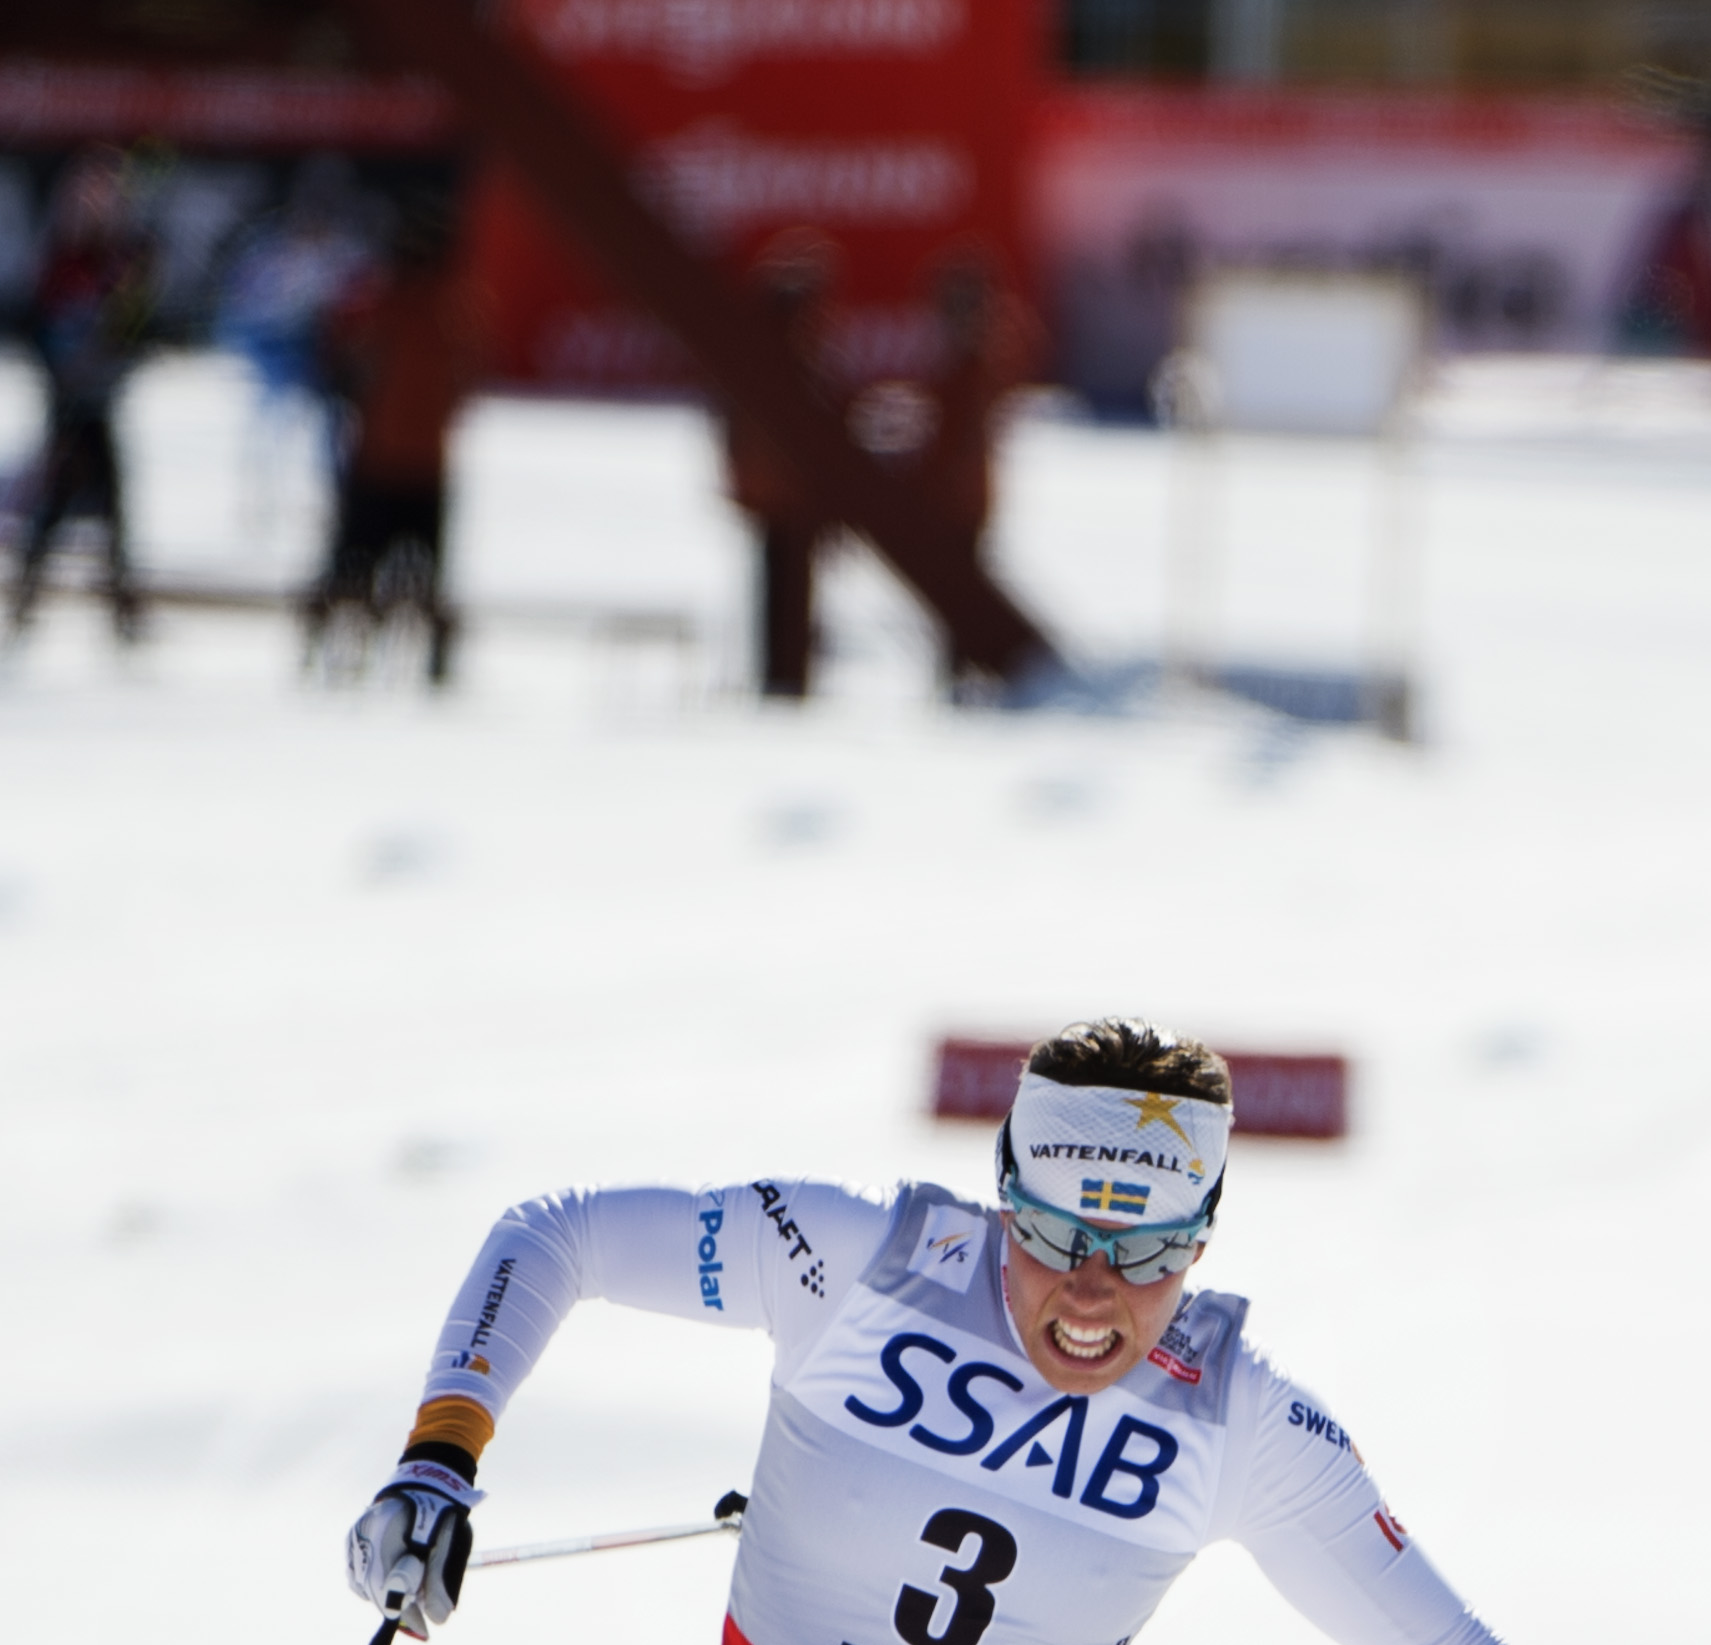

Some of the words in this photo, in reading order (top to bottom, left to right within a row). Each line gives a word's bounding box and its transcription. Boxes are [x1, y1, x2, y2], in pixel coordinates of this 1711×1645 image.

[1029, 1143, 1182, 1174] VATTENFALL
[469, 1258, 517, 1348] VATTENFALL
[698, 1209, 724, 1311] Polar
[843, 1332, 1180, 1520] SSAB
[1288, 1400, 1358, 1456] SWER
